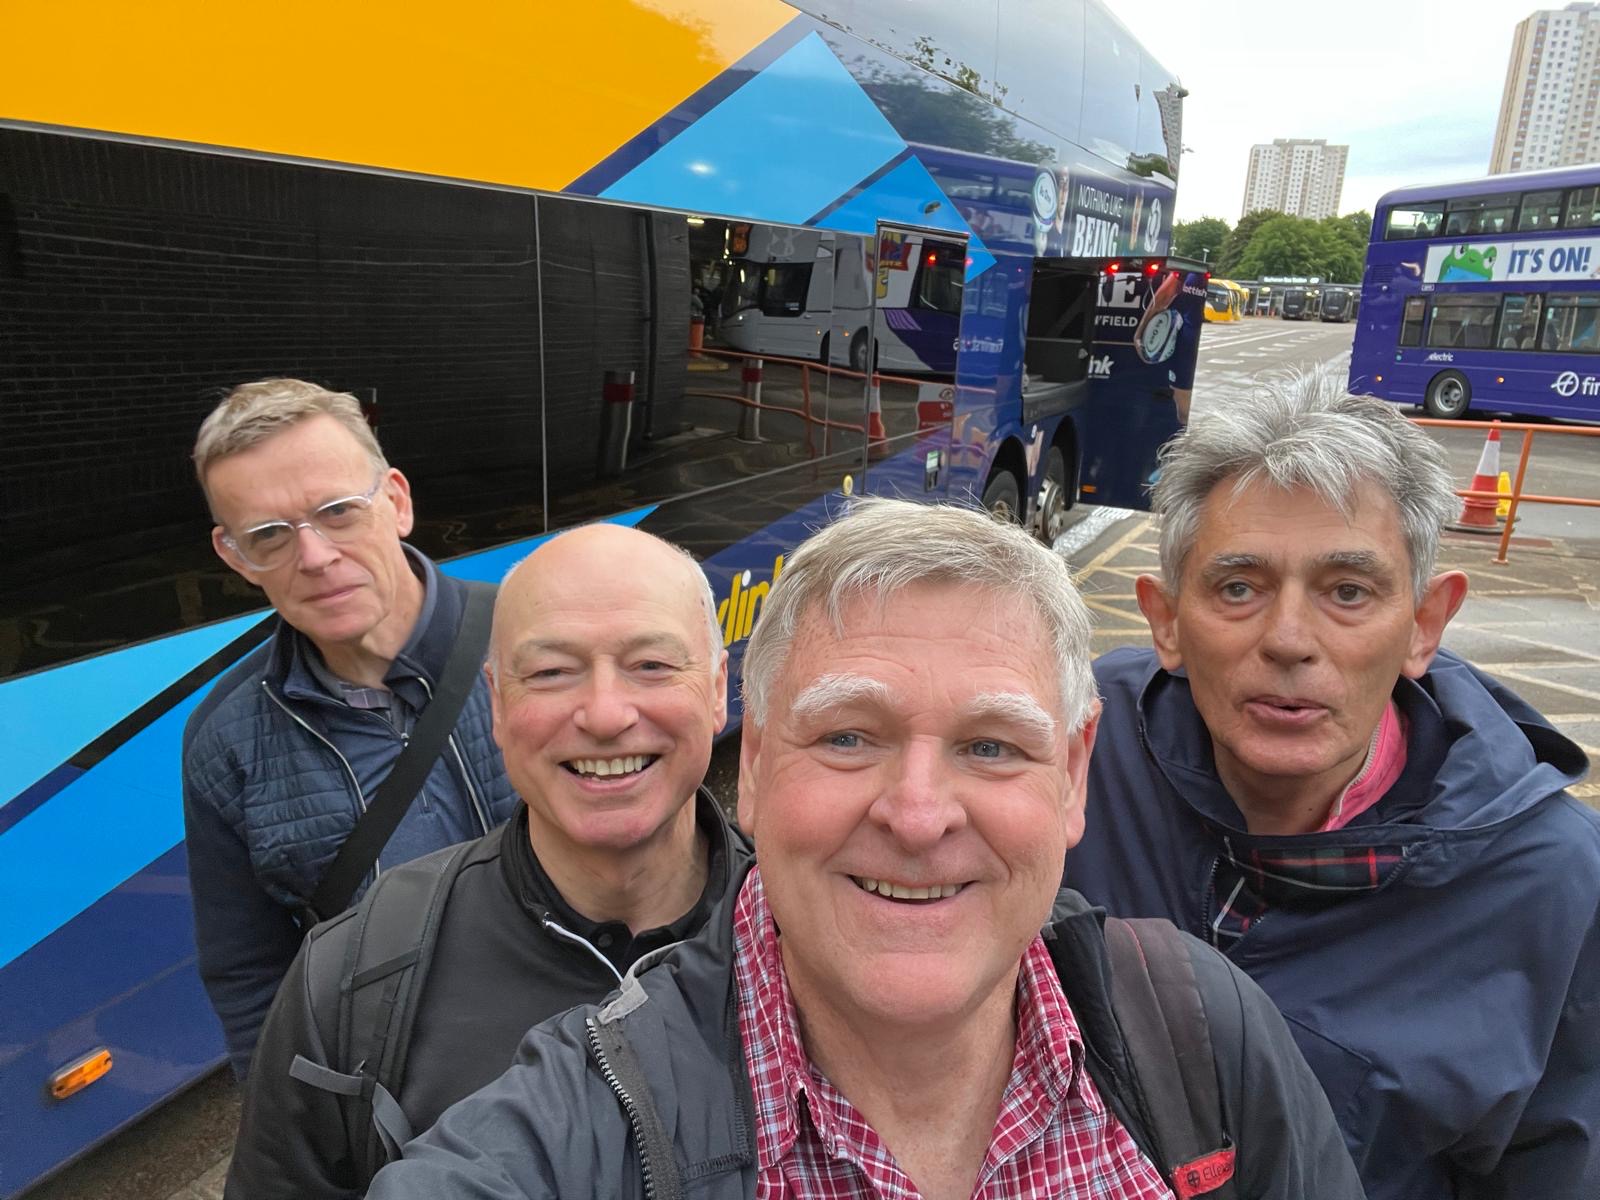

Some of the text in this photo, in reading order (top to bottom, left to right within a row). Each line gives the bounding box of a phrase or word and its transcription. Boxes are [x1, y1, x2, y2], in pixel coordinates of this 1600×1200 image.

[1078, 184, 1111, 215] NOTHING
[1109, 192, 1125, 218] LIKE
[1071, 213, 1120, 258] BEING
[1508, 246, 1591, 274] IT'S ON!
